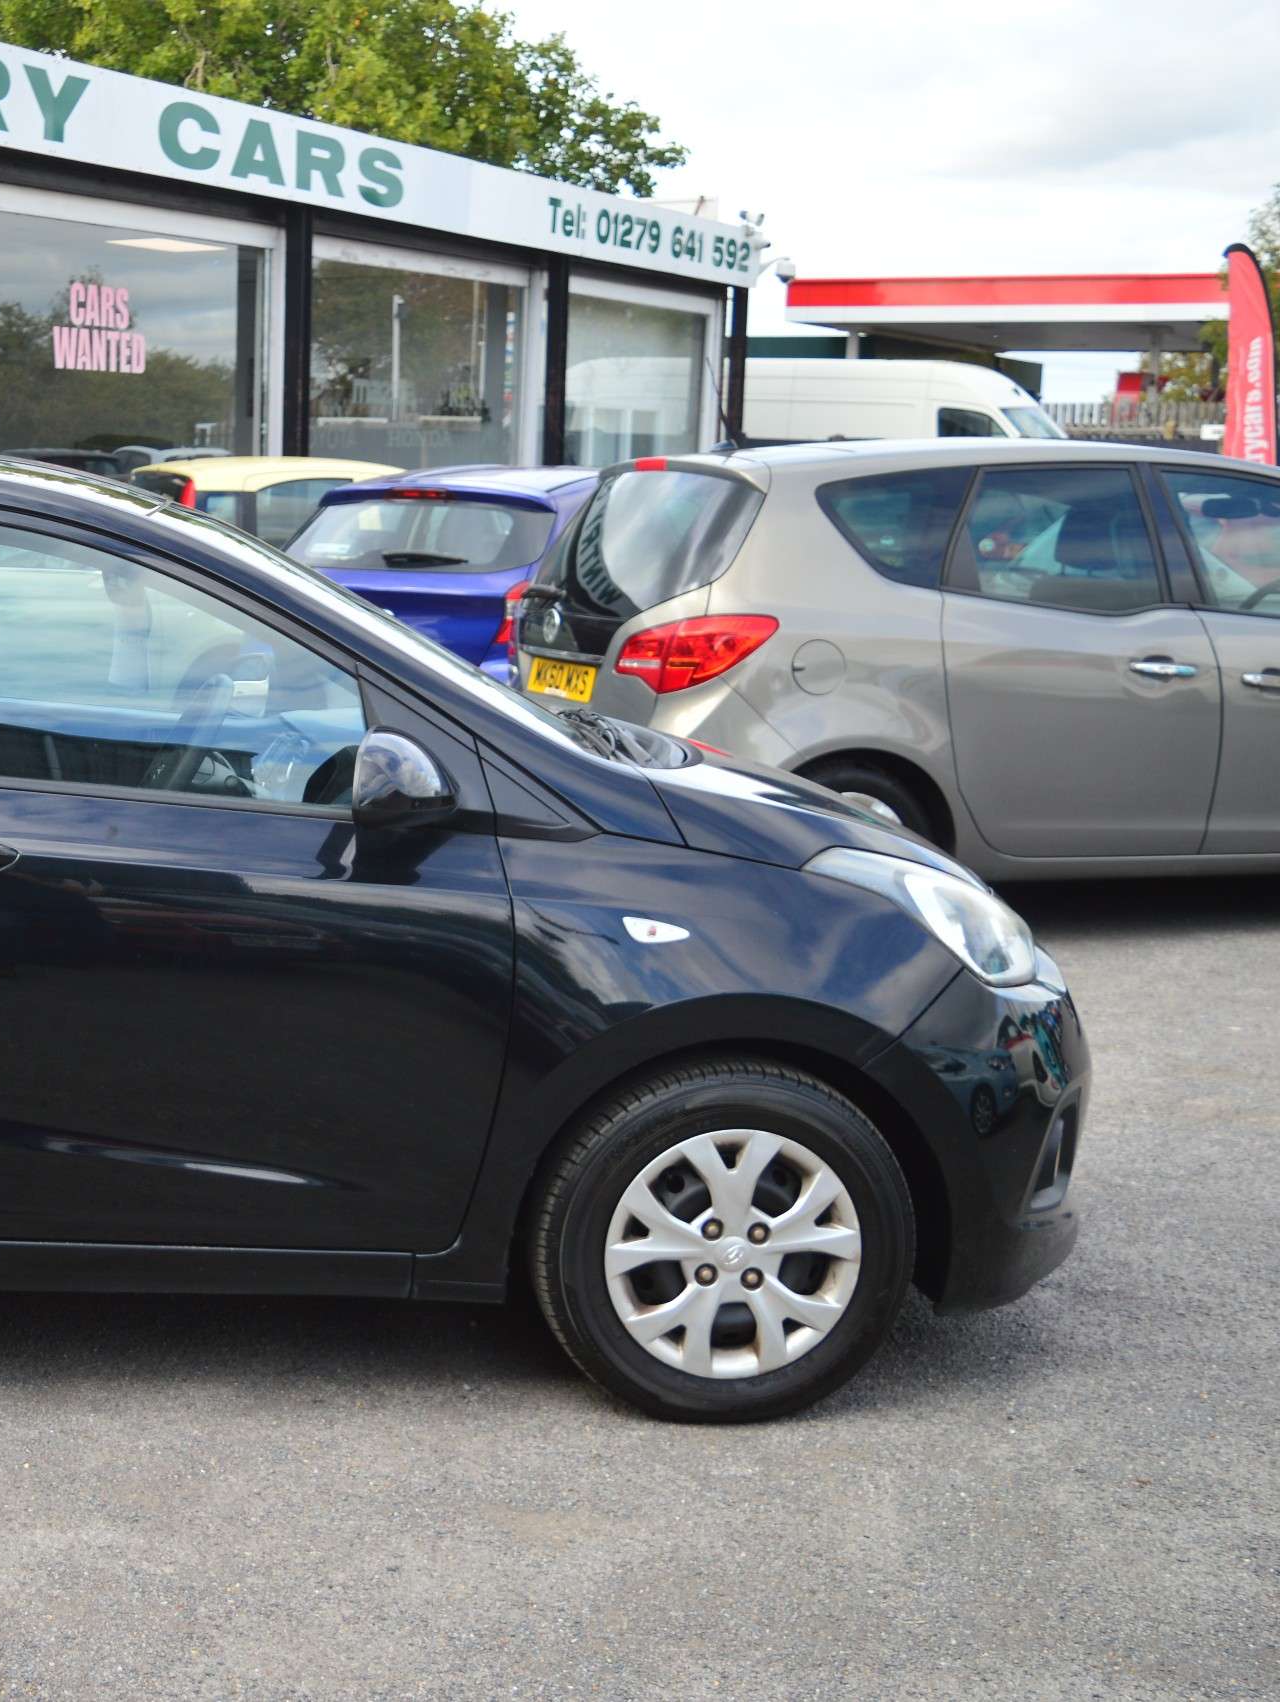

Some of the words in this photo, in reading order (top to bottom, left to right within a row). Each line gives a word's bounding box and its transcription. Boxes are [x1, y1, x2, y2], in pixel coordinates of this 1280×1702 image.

[158, 101, 404, 207] CARS
[548, 197, 587, 240] Tel:
[597, 209, 660, 254] 01279
[671, 226, 704, 263] 641
[712, 236, 751, 273] 592
[70, 282, 129, 330] CARS
[52, 325, 146, 375] WANTED
